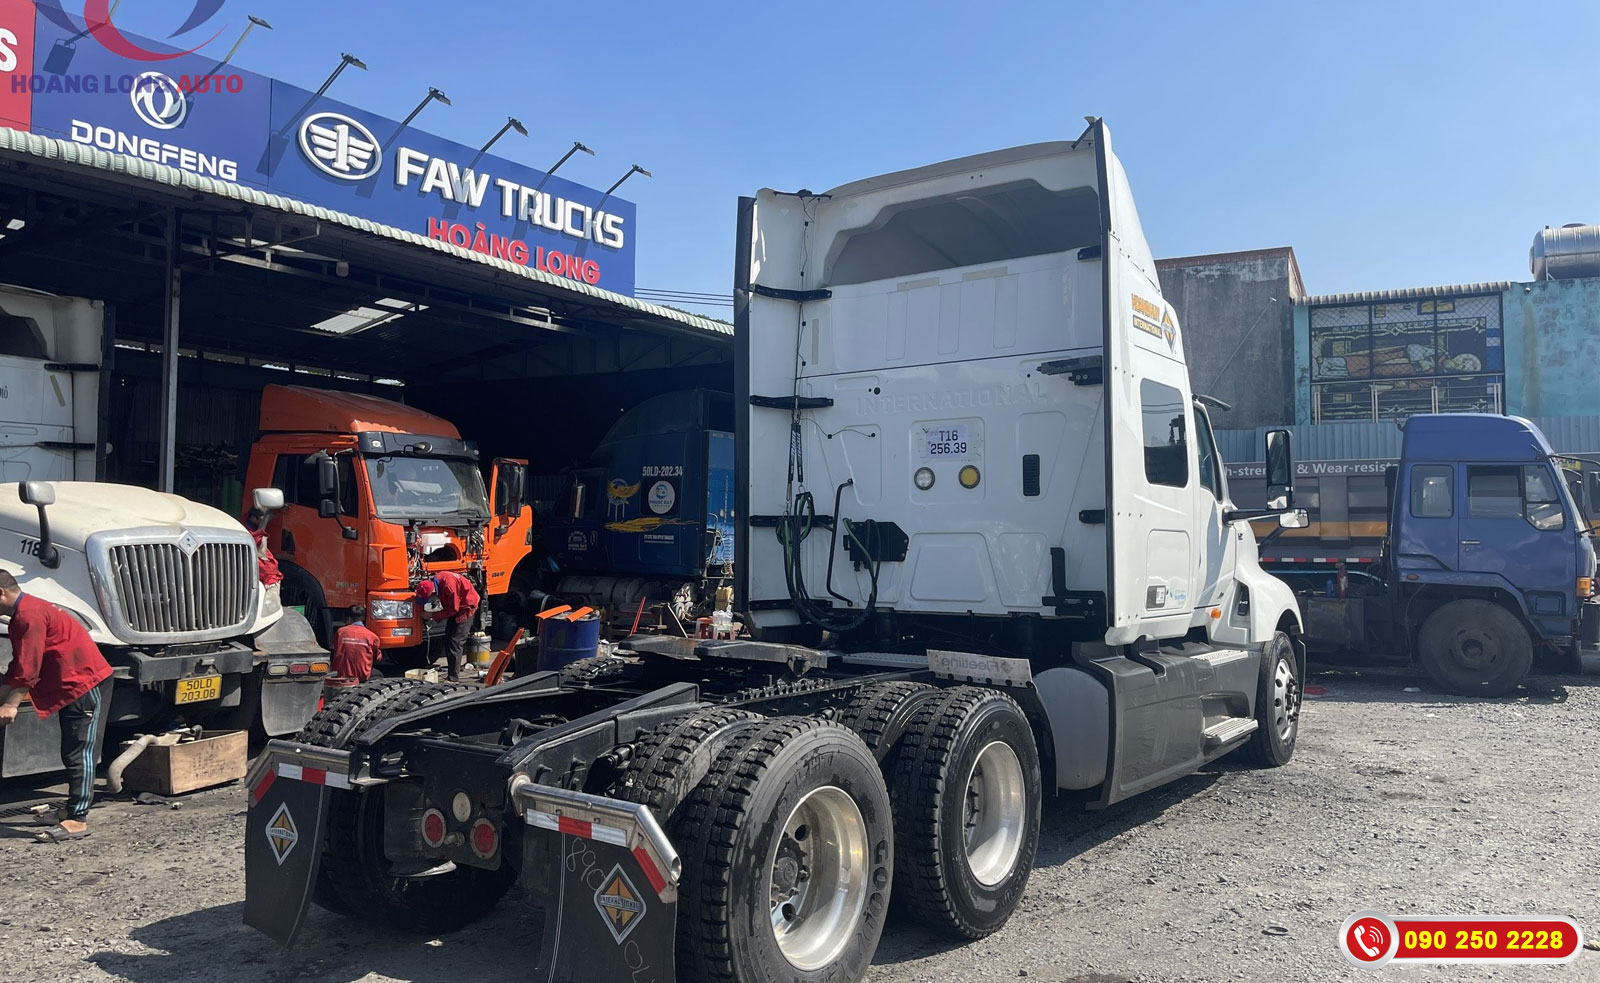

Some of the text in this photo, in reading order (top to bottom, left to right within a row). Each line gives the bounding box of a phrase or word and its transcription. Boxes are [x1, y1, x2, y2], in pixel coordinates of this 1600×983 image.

[71, 119, 238, 182] DONGFENG
[396, 146, 625, 249] FAW TRUCKS
[428, 217, 600, 285] HOÀNG LONG
[856, 382, 1048, 416] INTERNATIONAL
[939, 430, 959, 442] T16
[930, 442, 967, 454] 256.39
[1297, 464, 1309, 474] &
[186, 679, 213, 691] 50LD
[181, 689, 216, 703] 203.08
[600, 895, 641, 910] INTERNATIONAL
